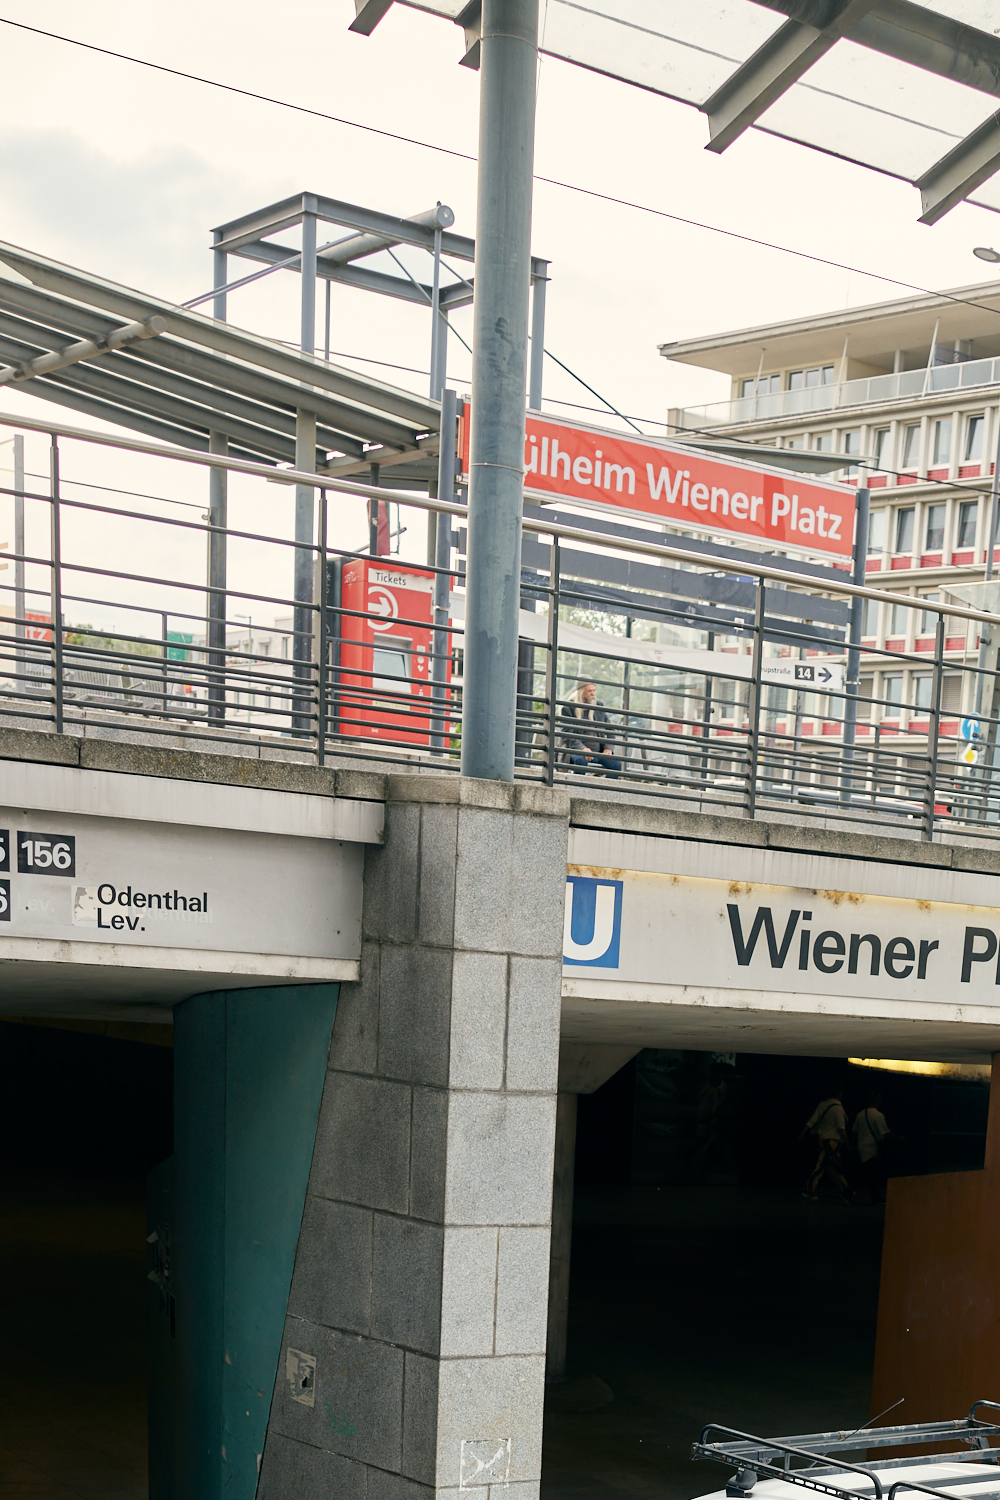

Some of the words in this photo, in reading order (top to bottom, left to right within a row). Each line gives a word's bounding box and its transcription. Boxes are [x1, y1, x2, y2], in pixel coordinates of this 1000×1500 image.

[525, 433, 636, 495] ülheim
[646, 462, 764, 522] Wiener
[771, 492, 842, 541] Platz
[375, 572, 407, 586] Tickets
[761, 666, 791, 675] eupstraße
[797, 667, 812, 680] 14
[21, 840, 71, 869] 156
[97, 883, 208, 913] Odenthal
[97, 907, 146, 931] Lev.
[564, 883, 613, 961] U
[726, 903, 939, 981] Wiener
